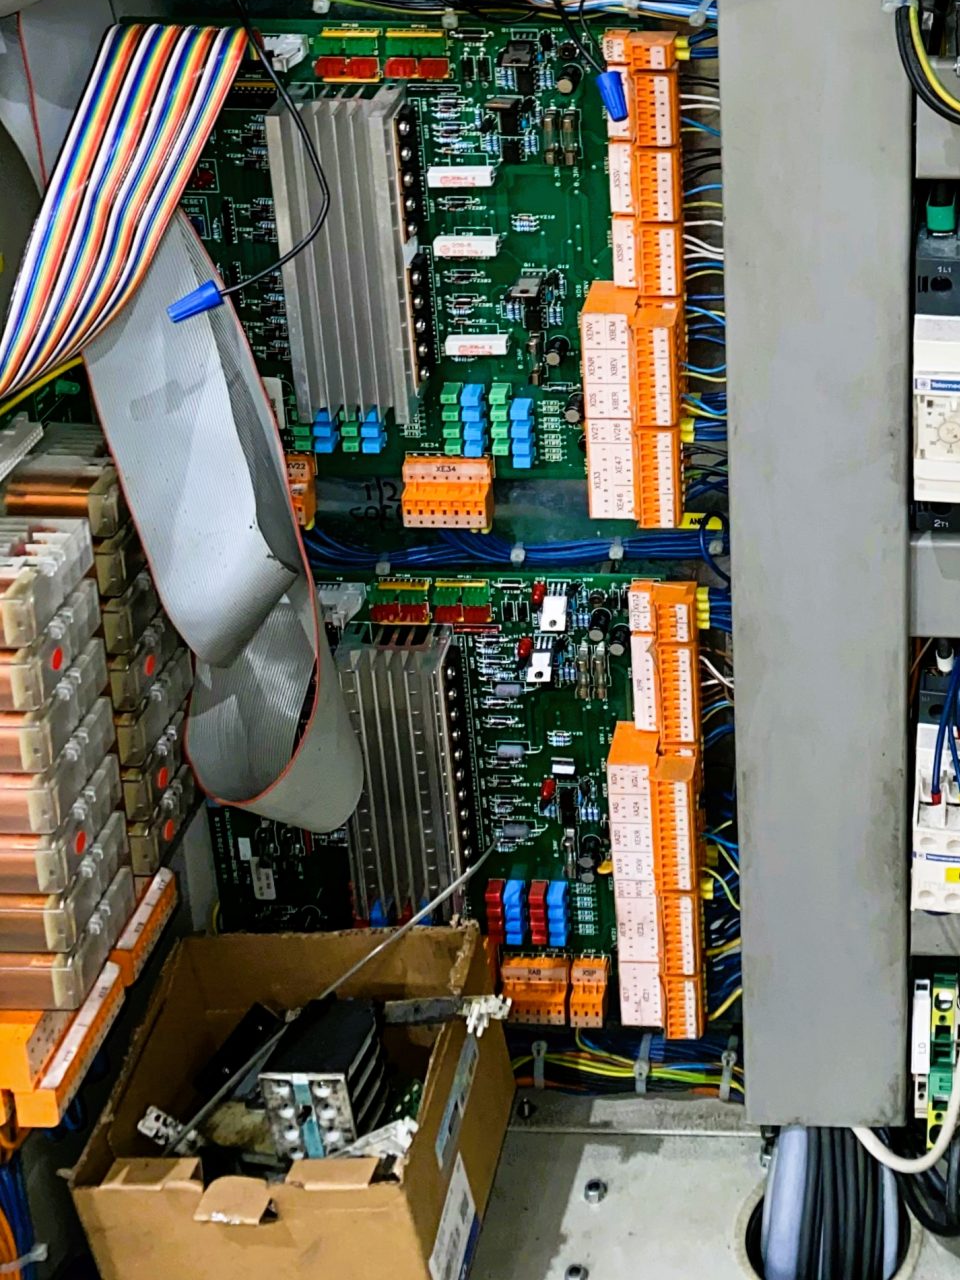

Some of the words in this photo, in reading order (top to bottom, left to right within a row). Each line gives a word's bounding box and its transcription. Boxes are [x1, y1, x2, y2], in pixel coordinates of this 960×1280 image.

[606, 39, 614, 60] XV25
[585, 321, 593, 341] XENV
[608, 321, 617, 341] XBEM
[587, 356, 595, 377] XENR
[610, 357, 618, 376] XBEV
[591, 422, 599, 441] XV21
[435, 465, 456, 473] XE34
[615, 455, 623, 474] XE47
